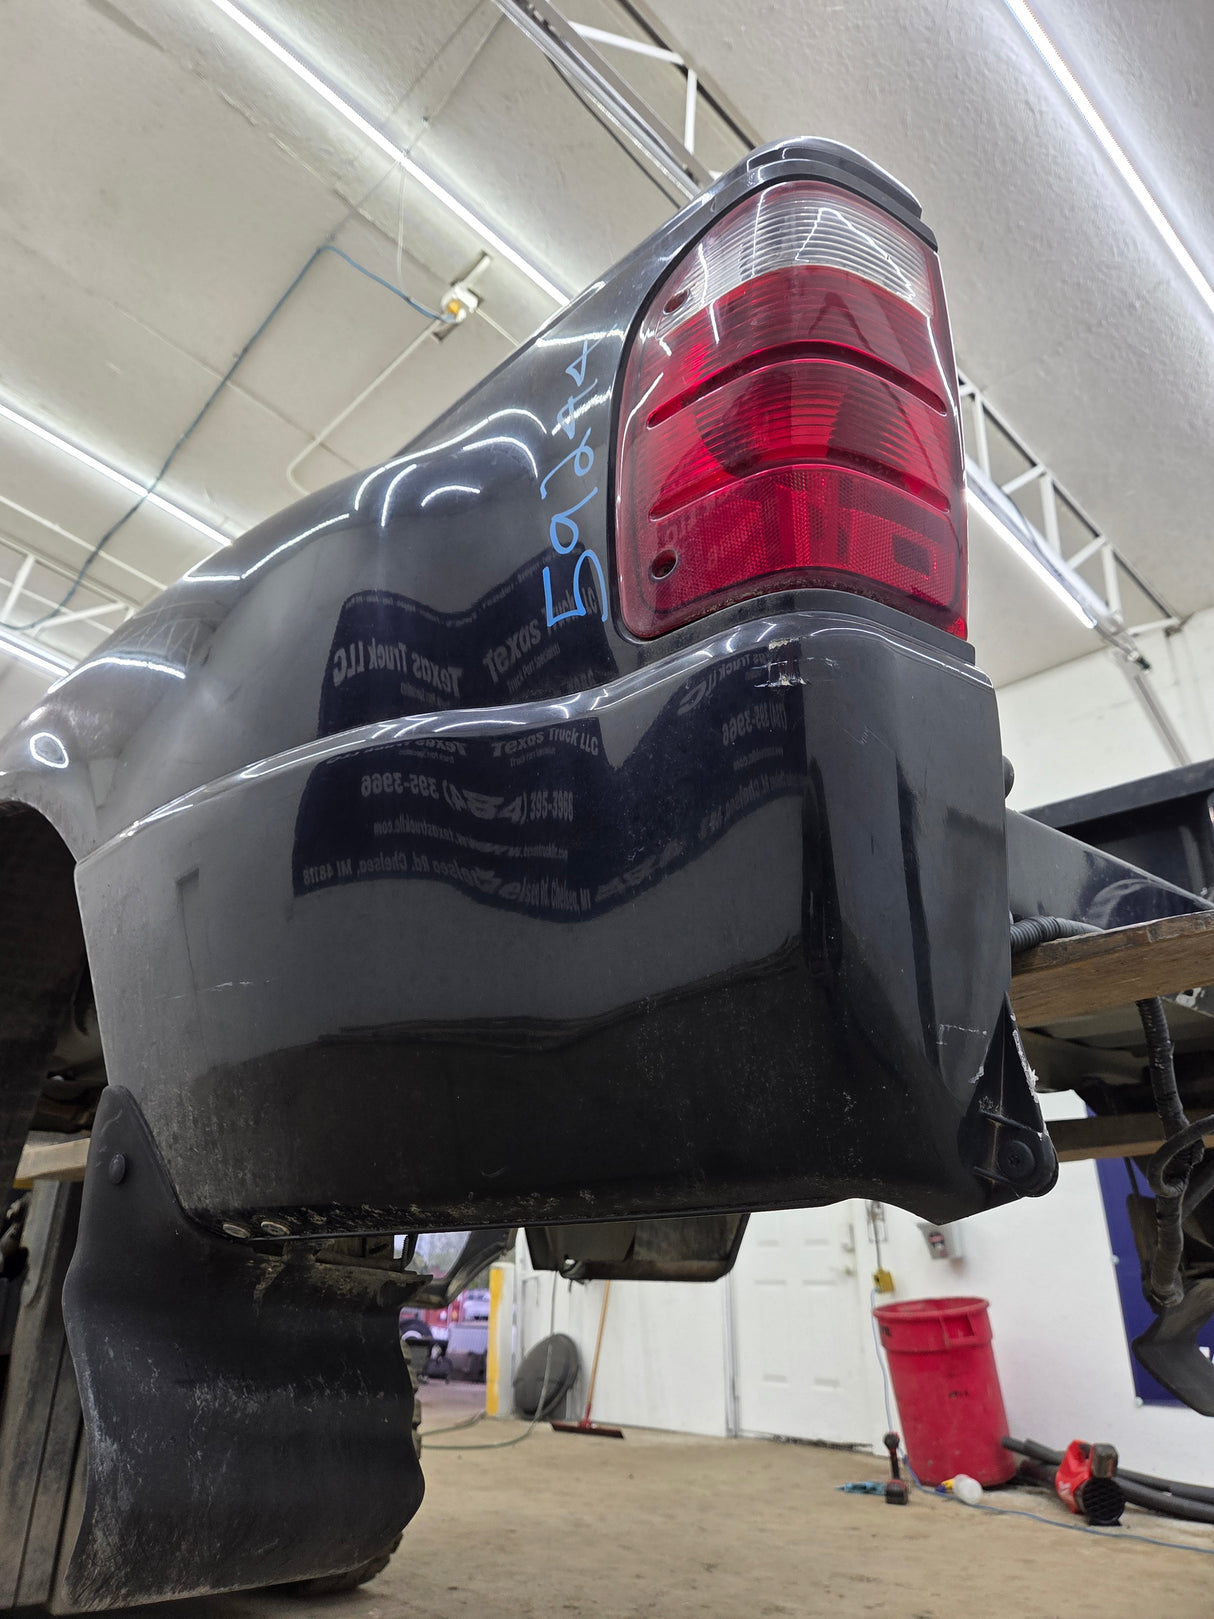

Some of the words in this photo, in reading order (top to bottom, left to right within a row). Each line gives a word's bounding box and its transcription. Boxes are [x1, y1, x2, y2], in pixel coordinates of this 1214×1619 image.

[482, 618, 542, 685] Texas
[491, 731, 544, 757] Texas
[548, 727, 578, 747] Truck
[580, 733, 599, 756] LLC
